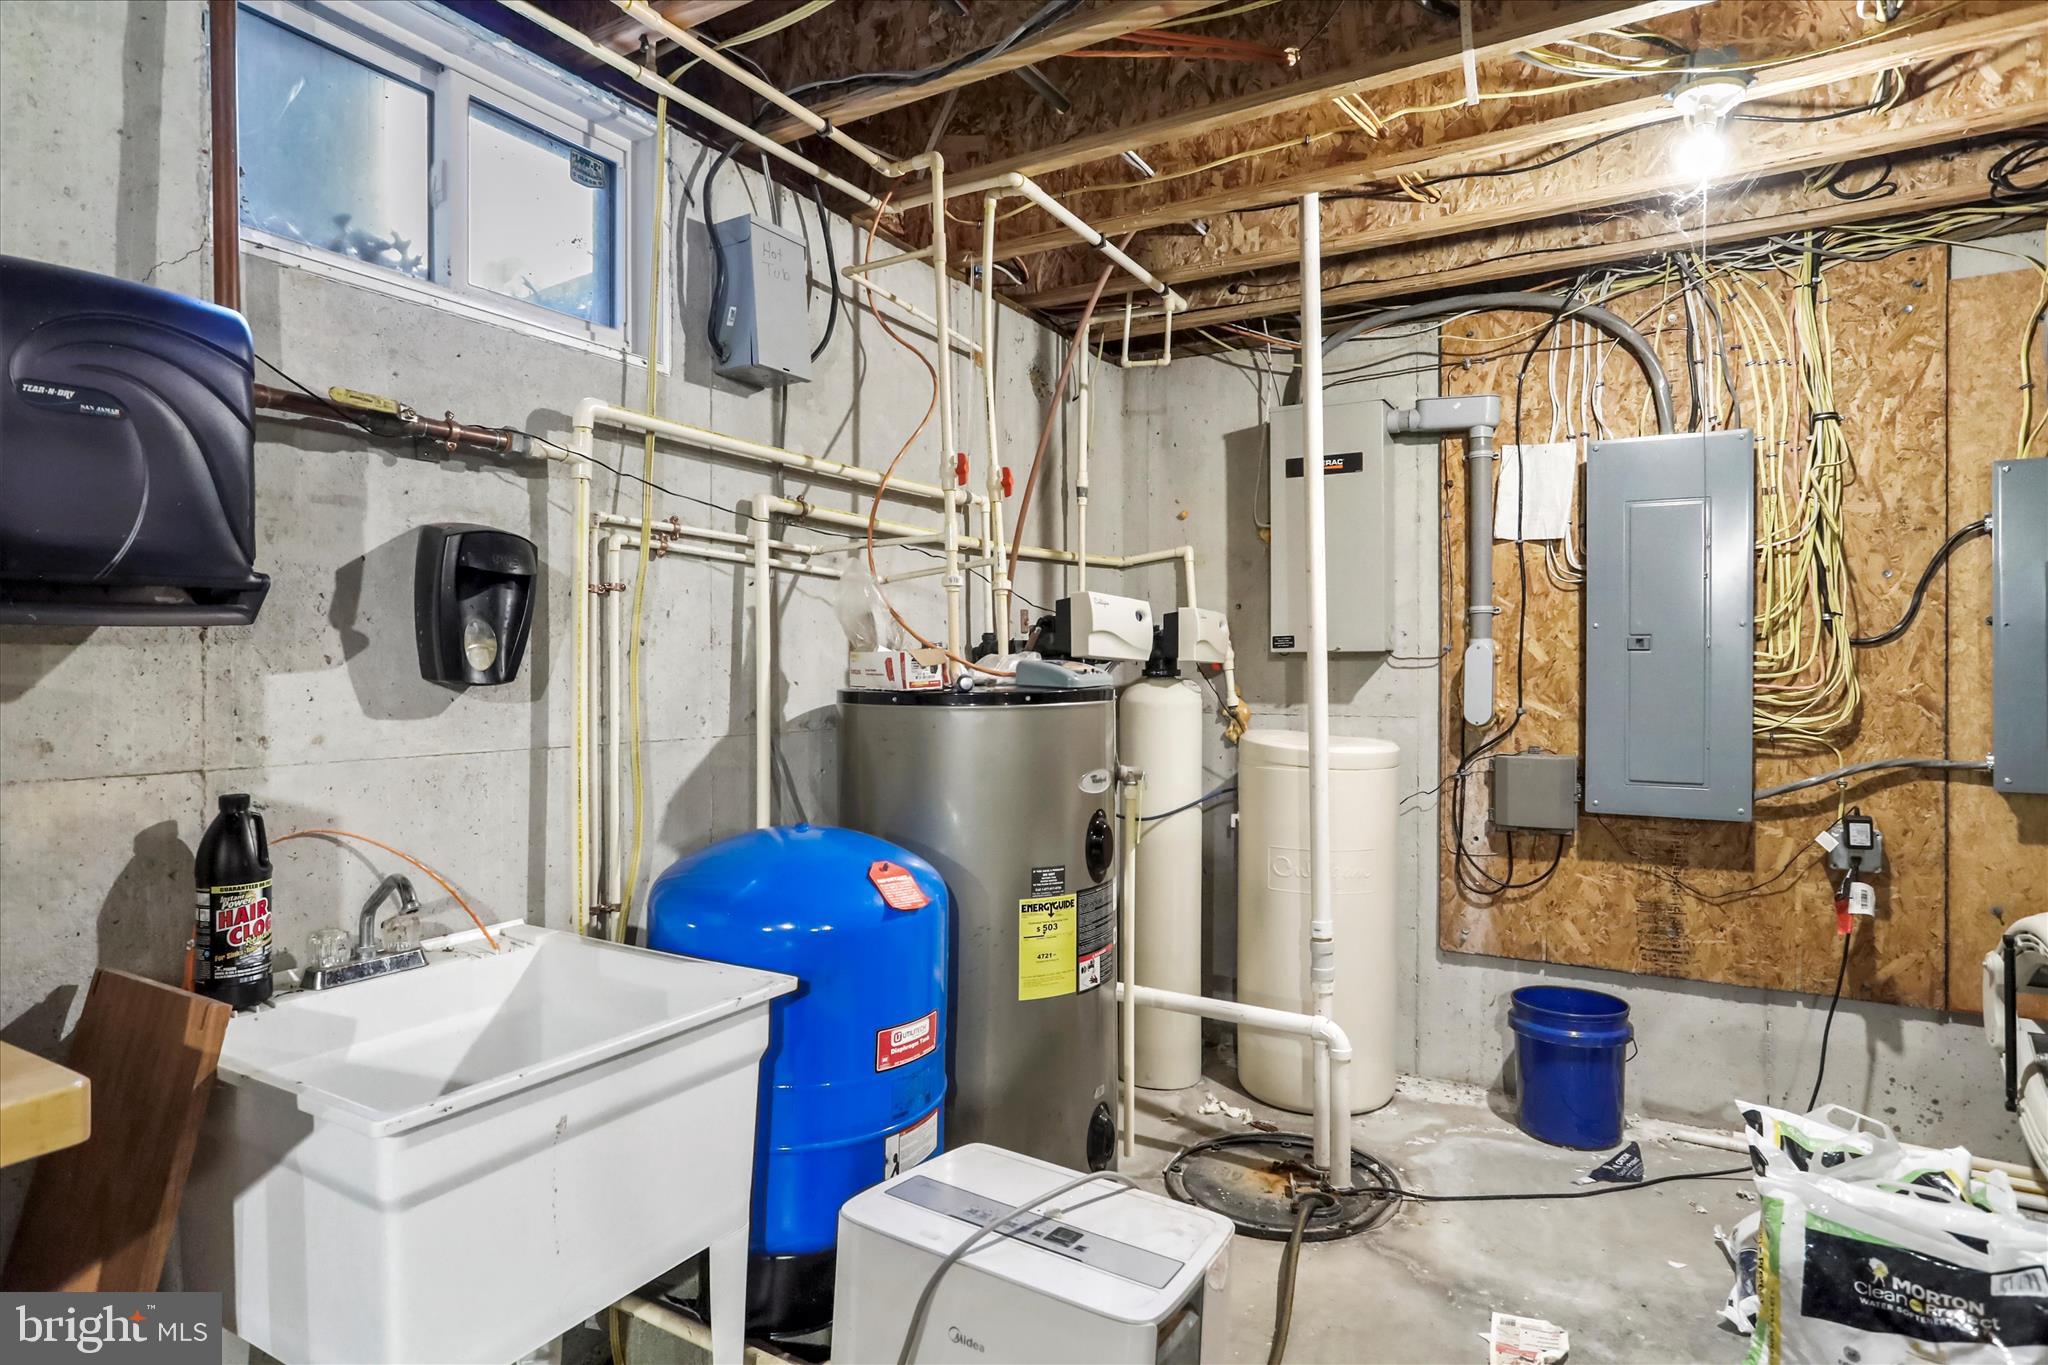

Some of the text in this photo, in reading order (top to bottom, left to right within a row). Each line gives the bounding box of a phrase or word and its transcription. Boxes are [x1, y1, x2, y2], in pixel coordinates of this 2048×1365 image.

[762, 241, 783, 261] Hot
[760, 260, 791, 281] Tub
[217, 898, 268, 932] HAIR
[1021, 899, 1075, 914] ENERGYGUIDE
[228, 913, 272, 946] CLOG
[1043, 923, 1058, 932] 503
[1853, 1280, 1908, 1306] Clean
[1925, 1303, 2002, 1331] Proect
[1859, 1296, 1894, 1311] WATER
[1891, 1275, 1985, 1316] MORTON
[948, 1326, 985, 1354] Midea
